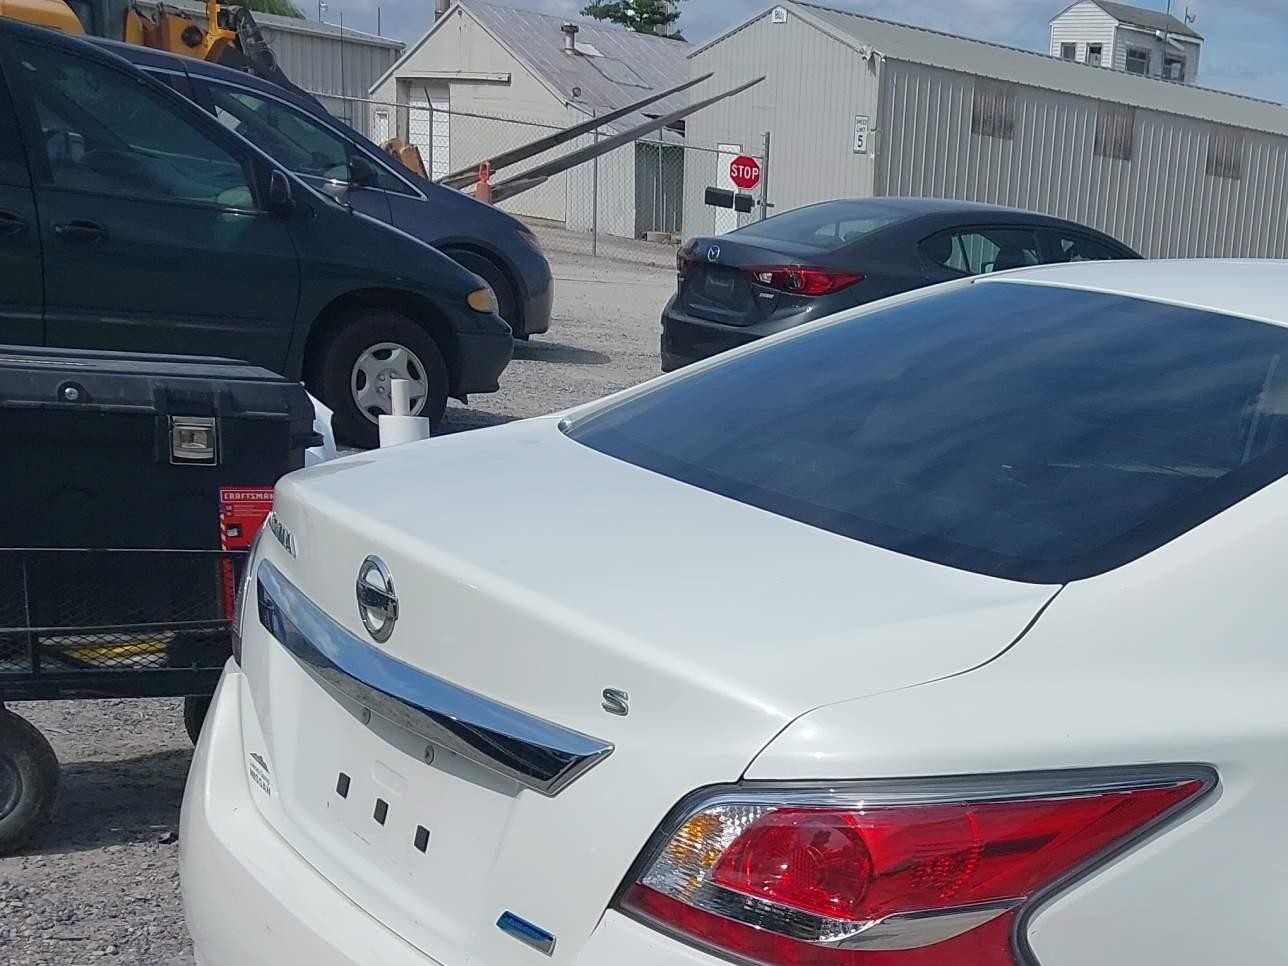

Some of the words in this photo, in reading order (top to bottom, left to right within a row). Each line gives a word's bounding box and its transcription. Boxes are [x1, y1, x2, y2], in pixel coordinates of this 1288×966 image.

[857, 134, 864, 148] 5
[731, 164, 760, 180] STOP
[601, 688, 629, 717] S
